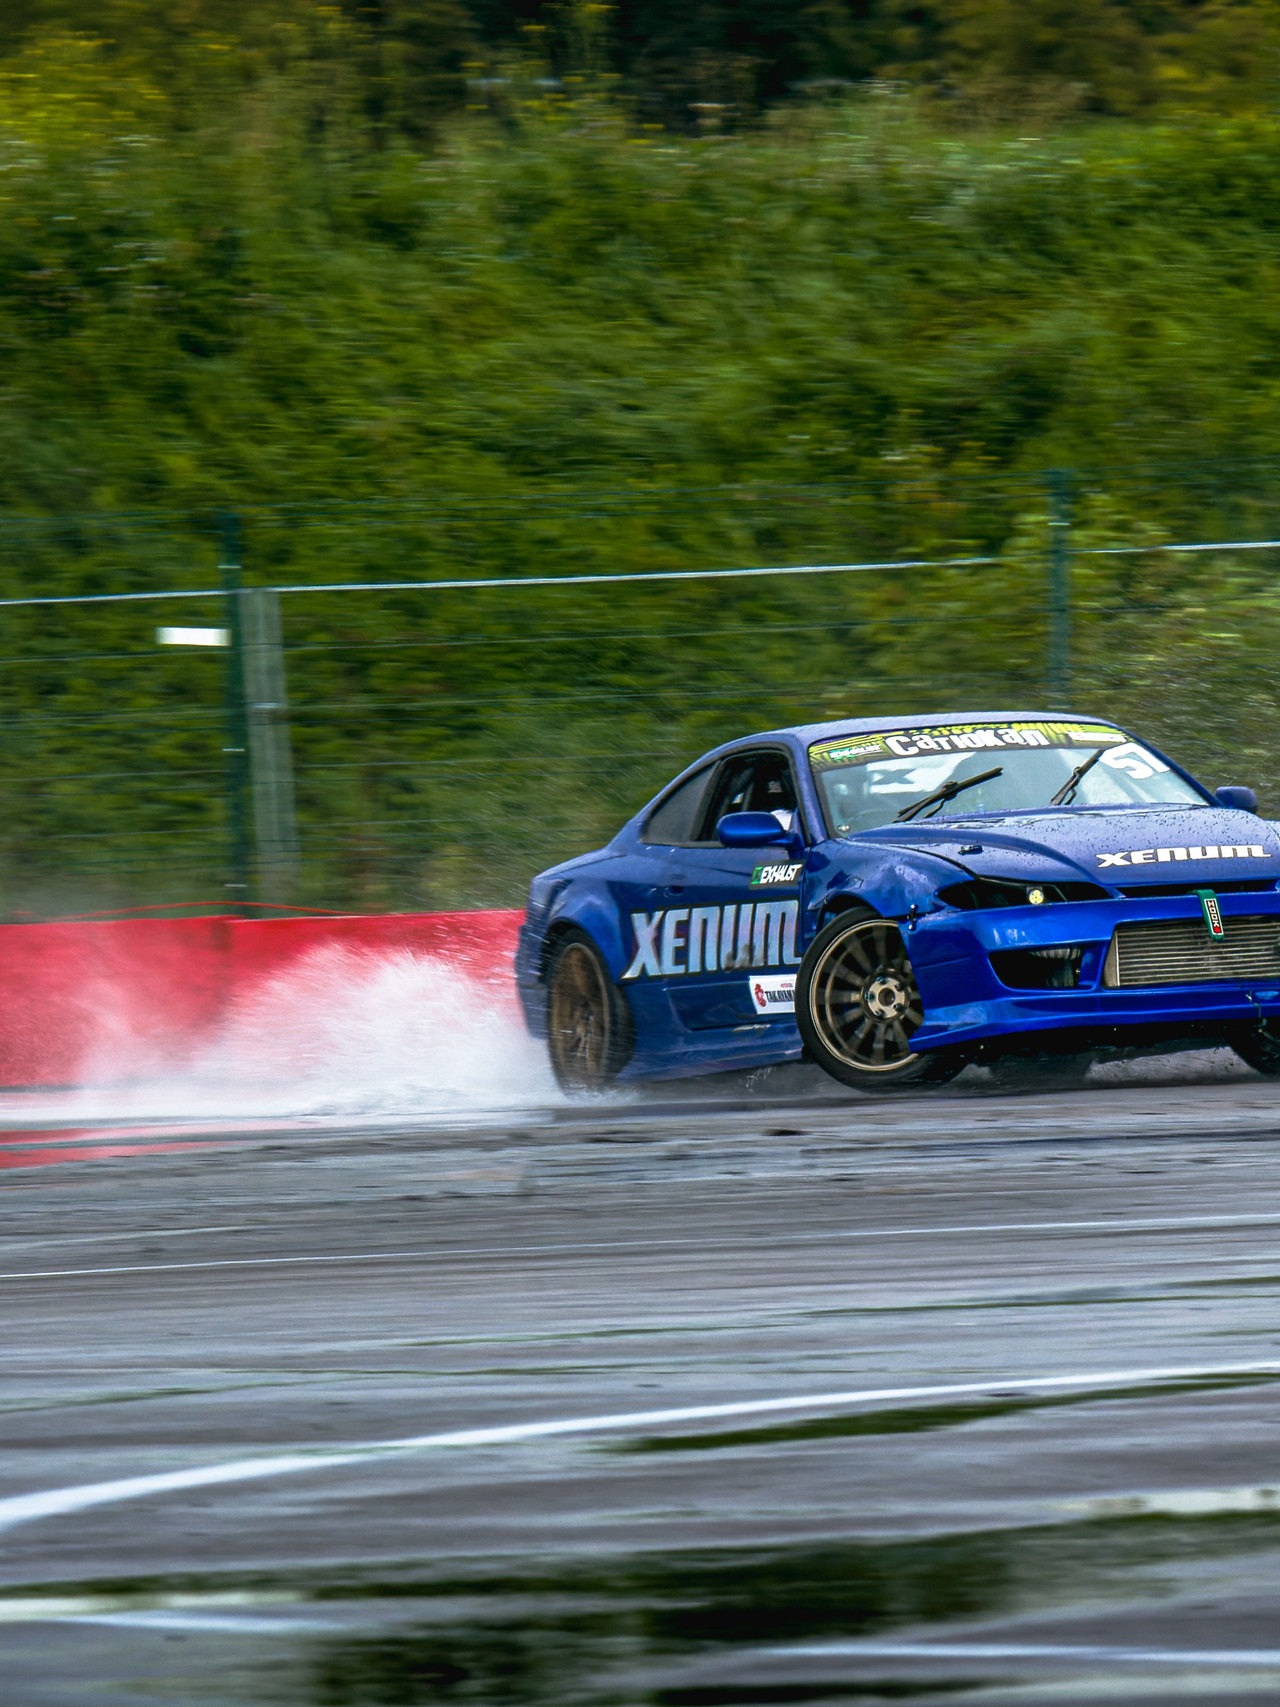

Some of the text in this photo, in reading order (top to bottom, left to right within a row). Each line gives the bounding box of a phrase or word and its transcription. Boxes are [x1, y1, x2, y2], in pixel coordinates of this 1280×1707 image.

[1096, 845, 1272, 868] XENUM
[760, 863, 803, 884] EXHAUST
[620, 899, 802, 980] XENUM
